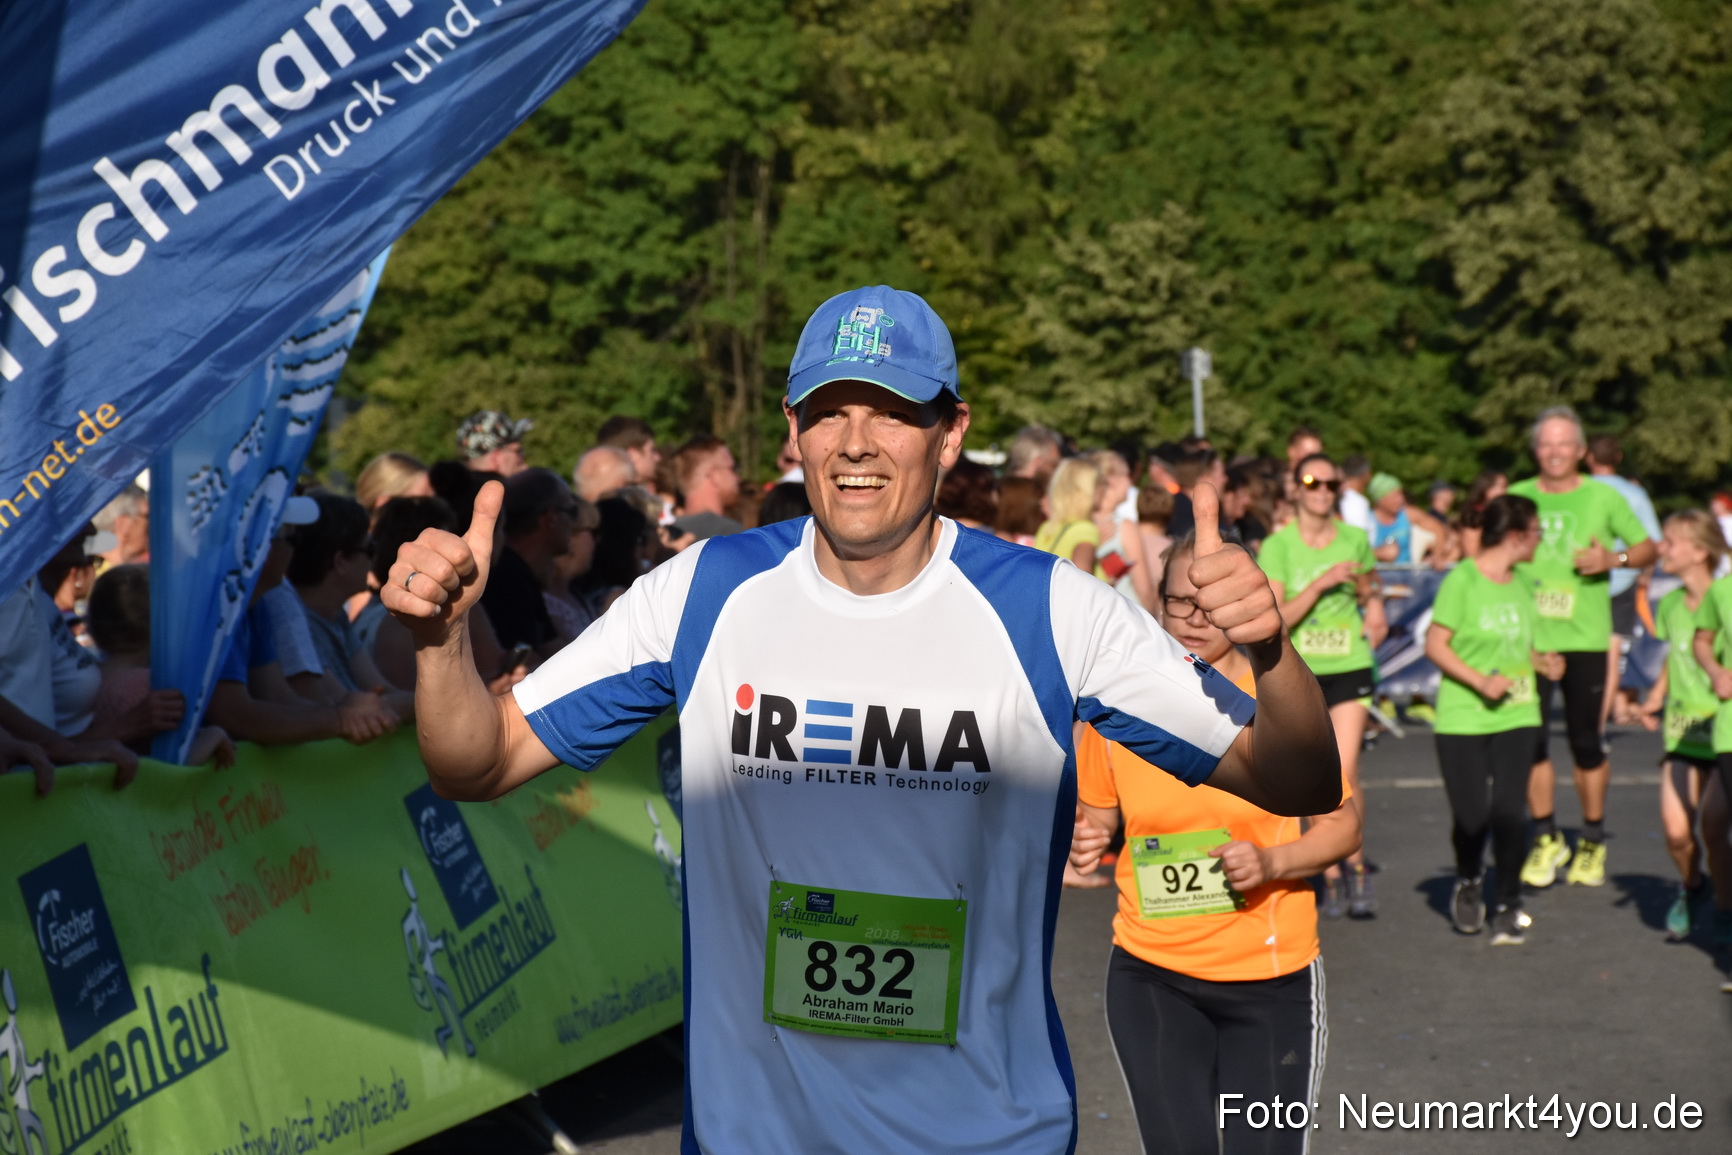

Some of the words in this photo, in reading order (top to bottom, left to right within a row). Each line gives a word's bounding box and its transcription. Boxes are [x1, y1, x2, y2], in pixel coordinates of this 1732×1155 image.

[263, 80, 396, 201] Druck
[392, 0, 481, 84] und
[0, 0, 413, 381] ischman
[0, 403, 121, 532] n-net.de
[732, 759, 793, 784] Leading
[804, 767, 877, 786] FILTER
[886, 773, 991, 795] Technology
[1162, 862, 1203, 894] 92
[48, 907, 95, 953] Fischer
[443, 862, 557, 1014] firmenlauf
[793, 906, 859, 926] firmenlauf
[864, 927, 901, 940] 2018
[804, 940, 915, 999] 832
[802, 993, 870, 1012] Abraham
[873, 1000, 914, 1016] Mario
[808, 1009, 871, 1025] IREMA-Filter
[874, 1015, 904, 1027] GmbH
[44, 952, 229, 1151] firmenlauf
